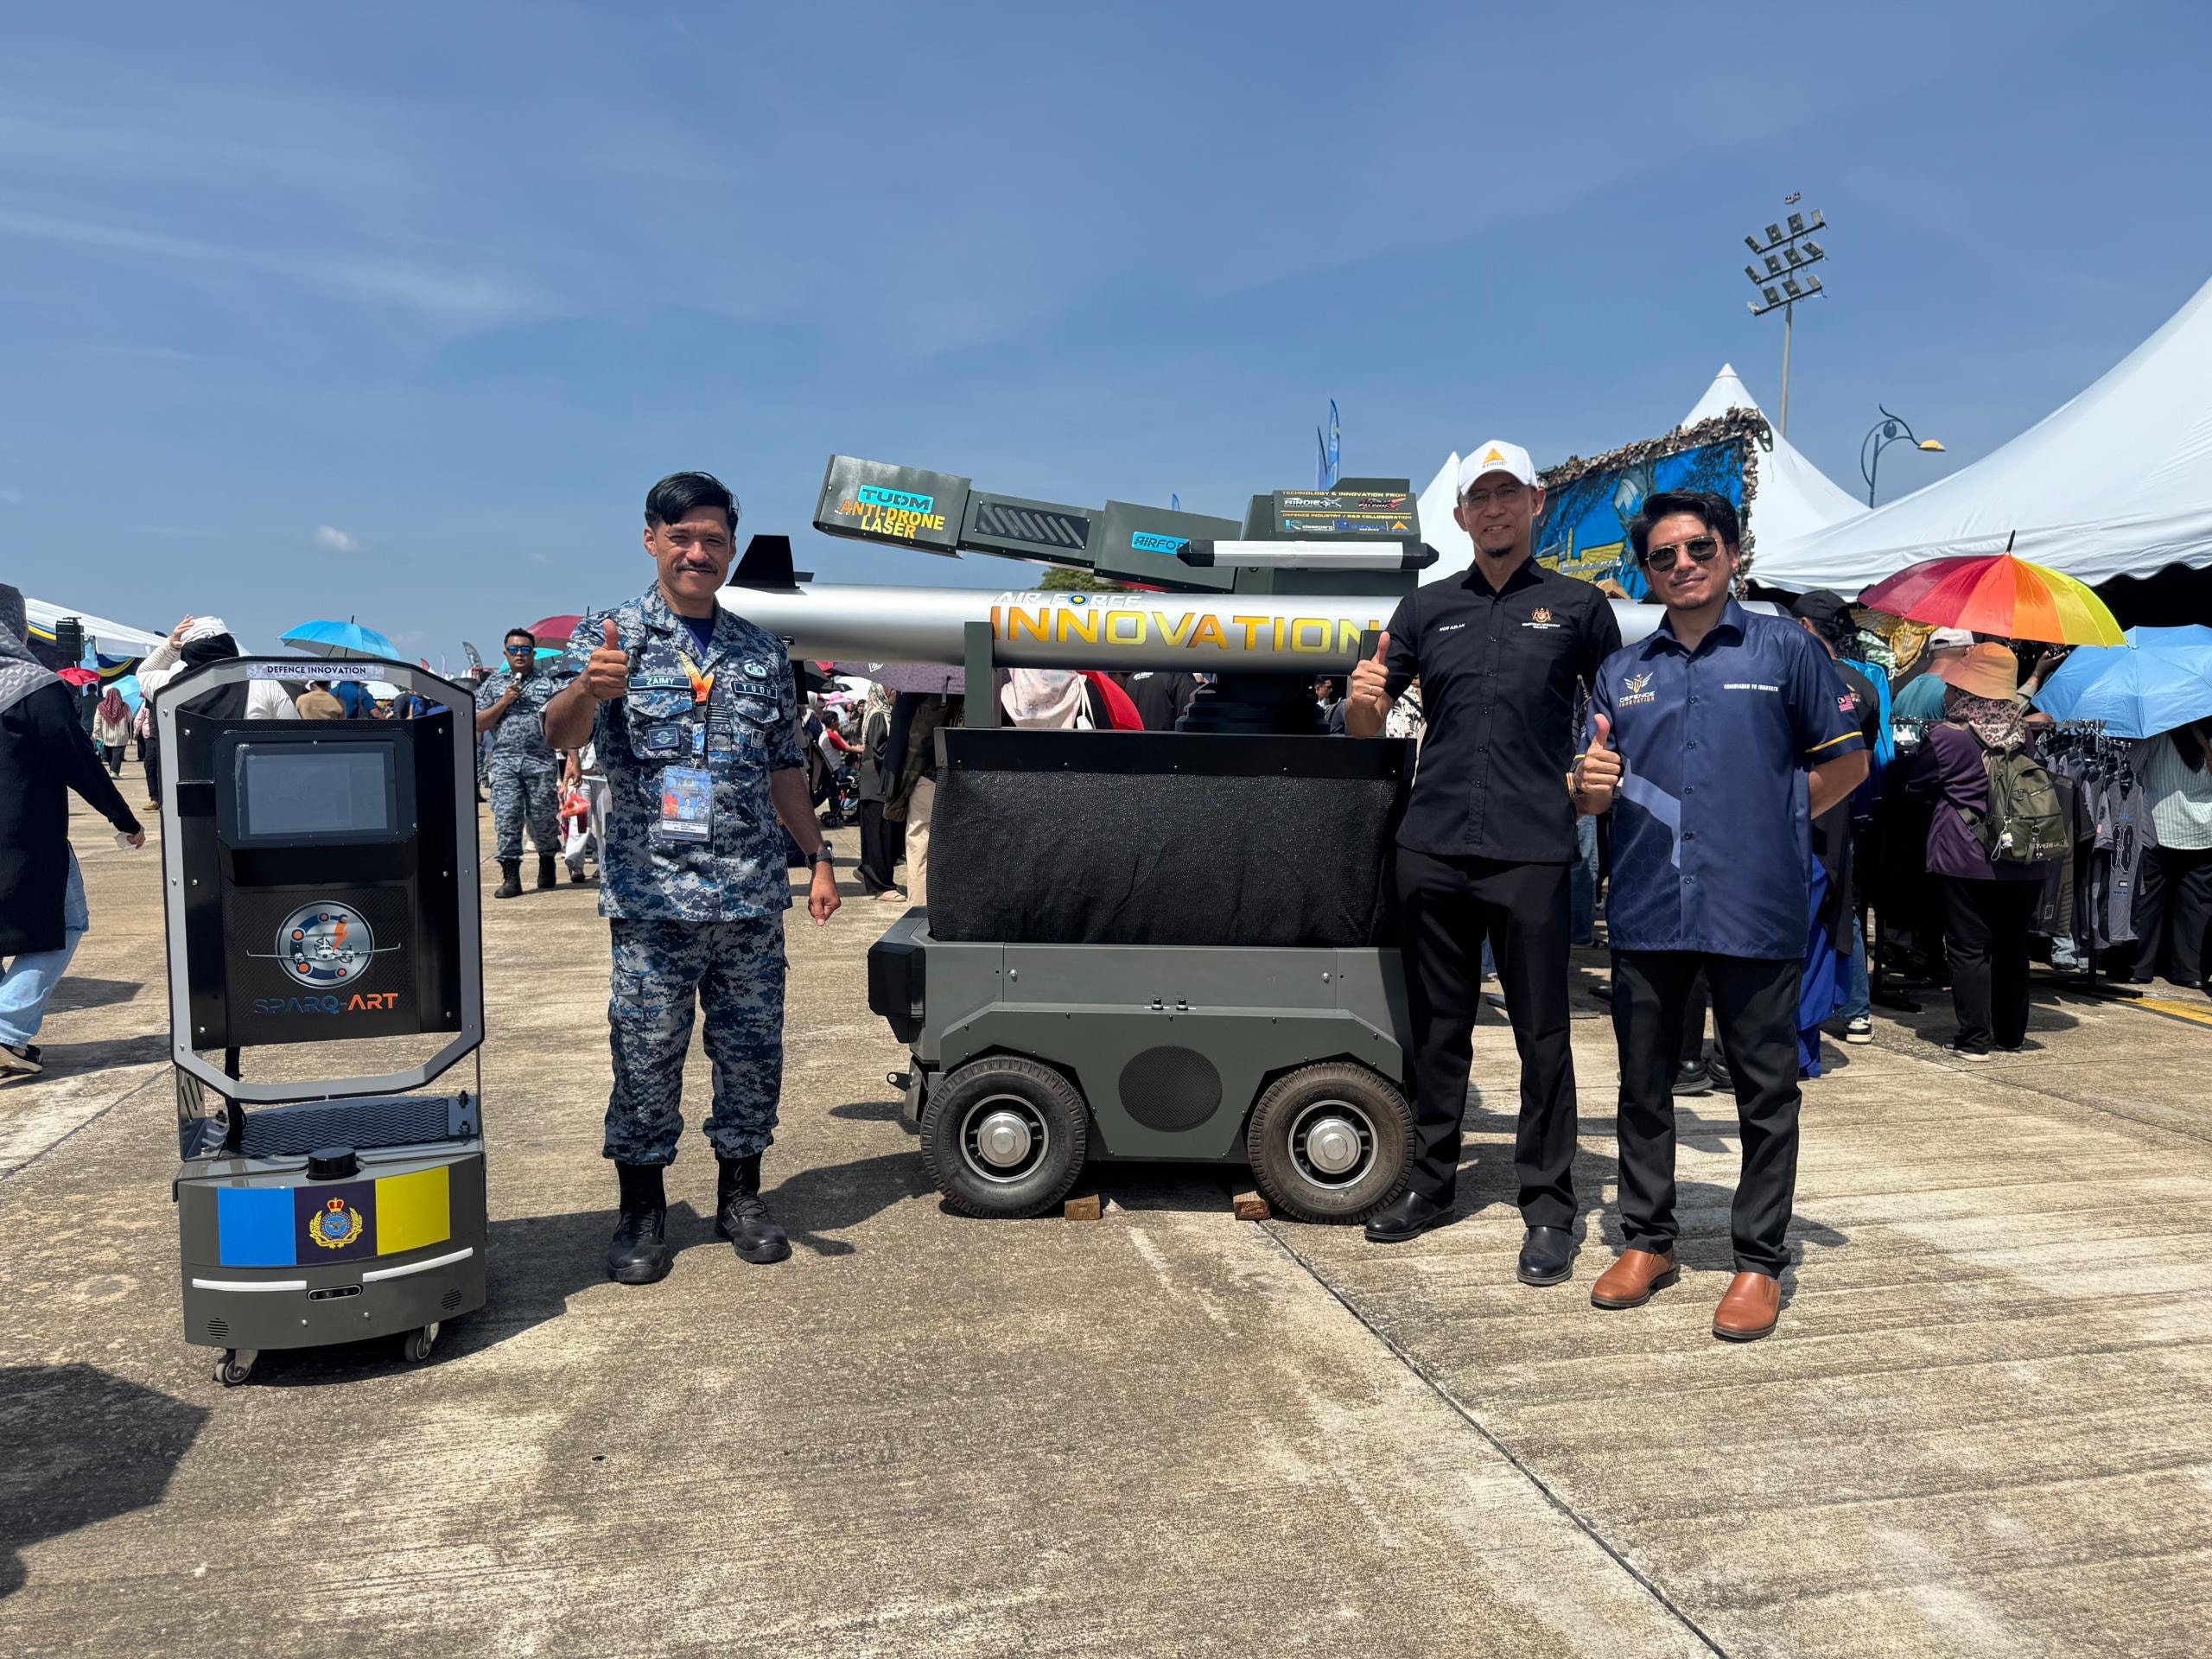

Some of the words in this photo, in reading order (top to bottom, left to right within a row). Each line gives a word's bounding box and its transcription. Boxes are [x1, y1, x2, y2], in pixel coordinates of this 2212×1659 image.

[862, 488, 931, 511] TUDM
[840, 499, 945, 531] ANTI-DRONE
[861, 515, 918, 539] LASER
[993, 591, 1039, 604] AIR
[990, 607, 1380, 654] INNOVATION
[267, 665, 305, 674] DEFENCE
[308, 666, 366, 675] INNOVATION
[1619, 690, 1656, 703] DEFENCE
[253, 993, 398, 1016] SPARQ-ART
